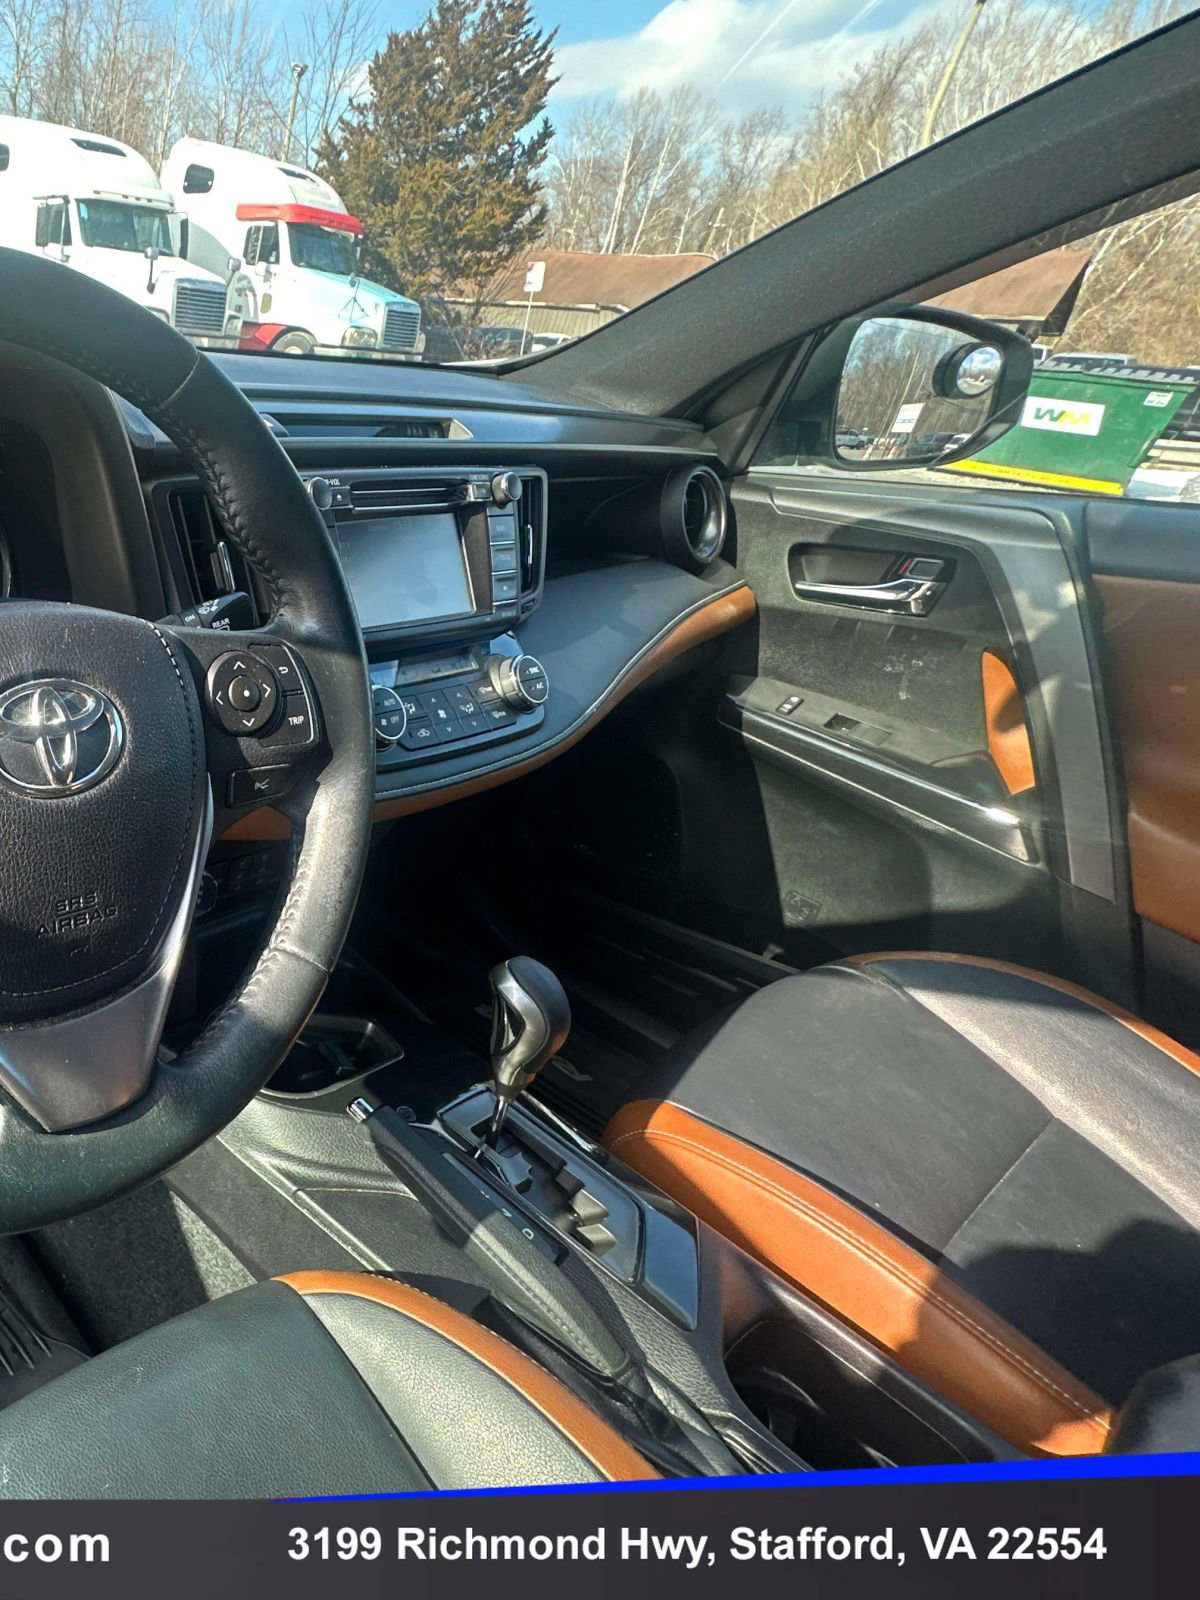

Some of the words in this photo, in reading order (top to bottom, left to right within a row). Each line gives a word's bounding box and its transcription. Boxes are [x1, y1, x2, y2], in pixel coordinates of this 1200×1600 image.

[1034, 407, 1089, 425] WM
[184, 614, 196, 622] ON
[211, 617, 230, 629] REAR
[288, 715, 305, 726] TRIP
[57, 892, 99, 914] SRS
[37, 905, 119, 938] AIRBAG
[521, 1228, 535, 1240] D
